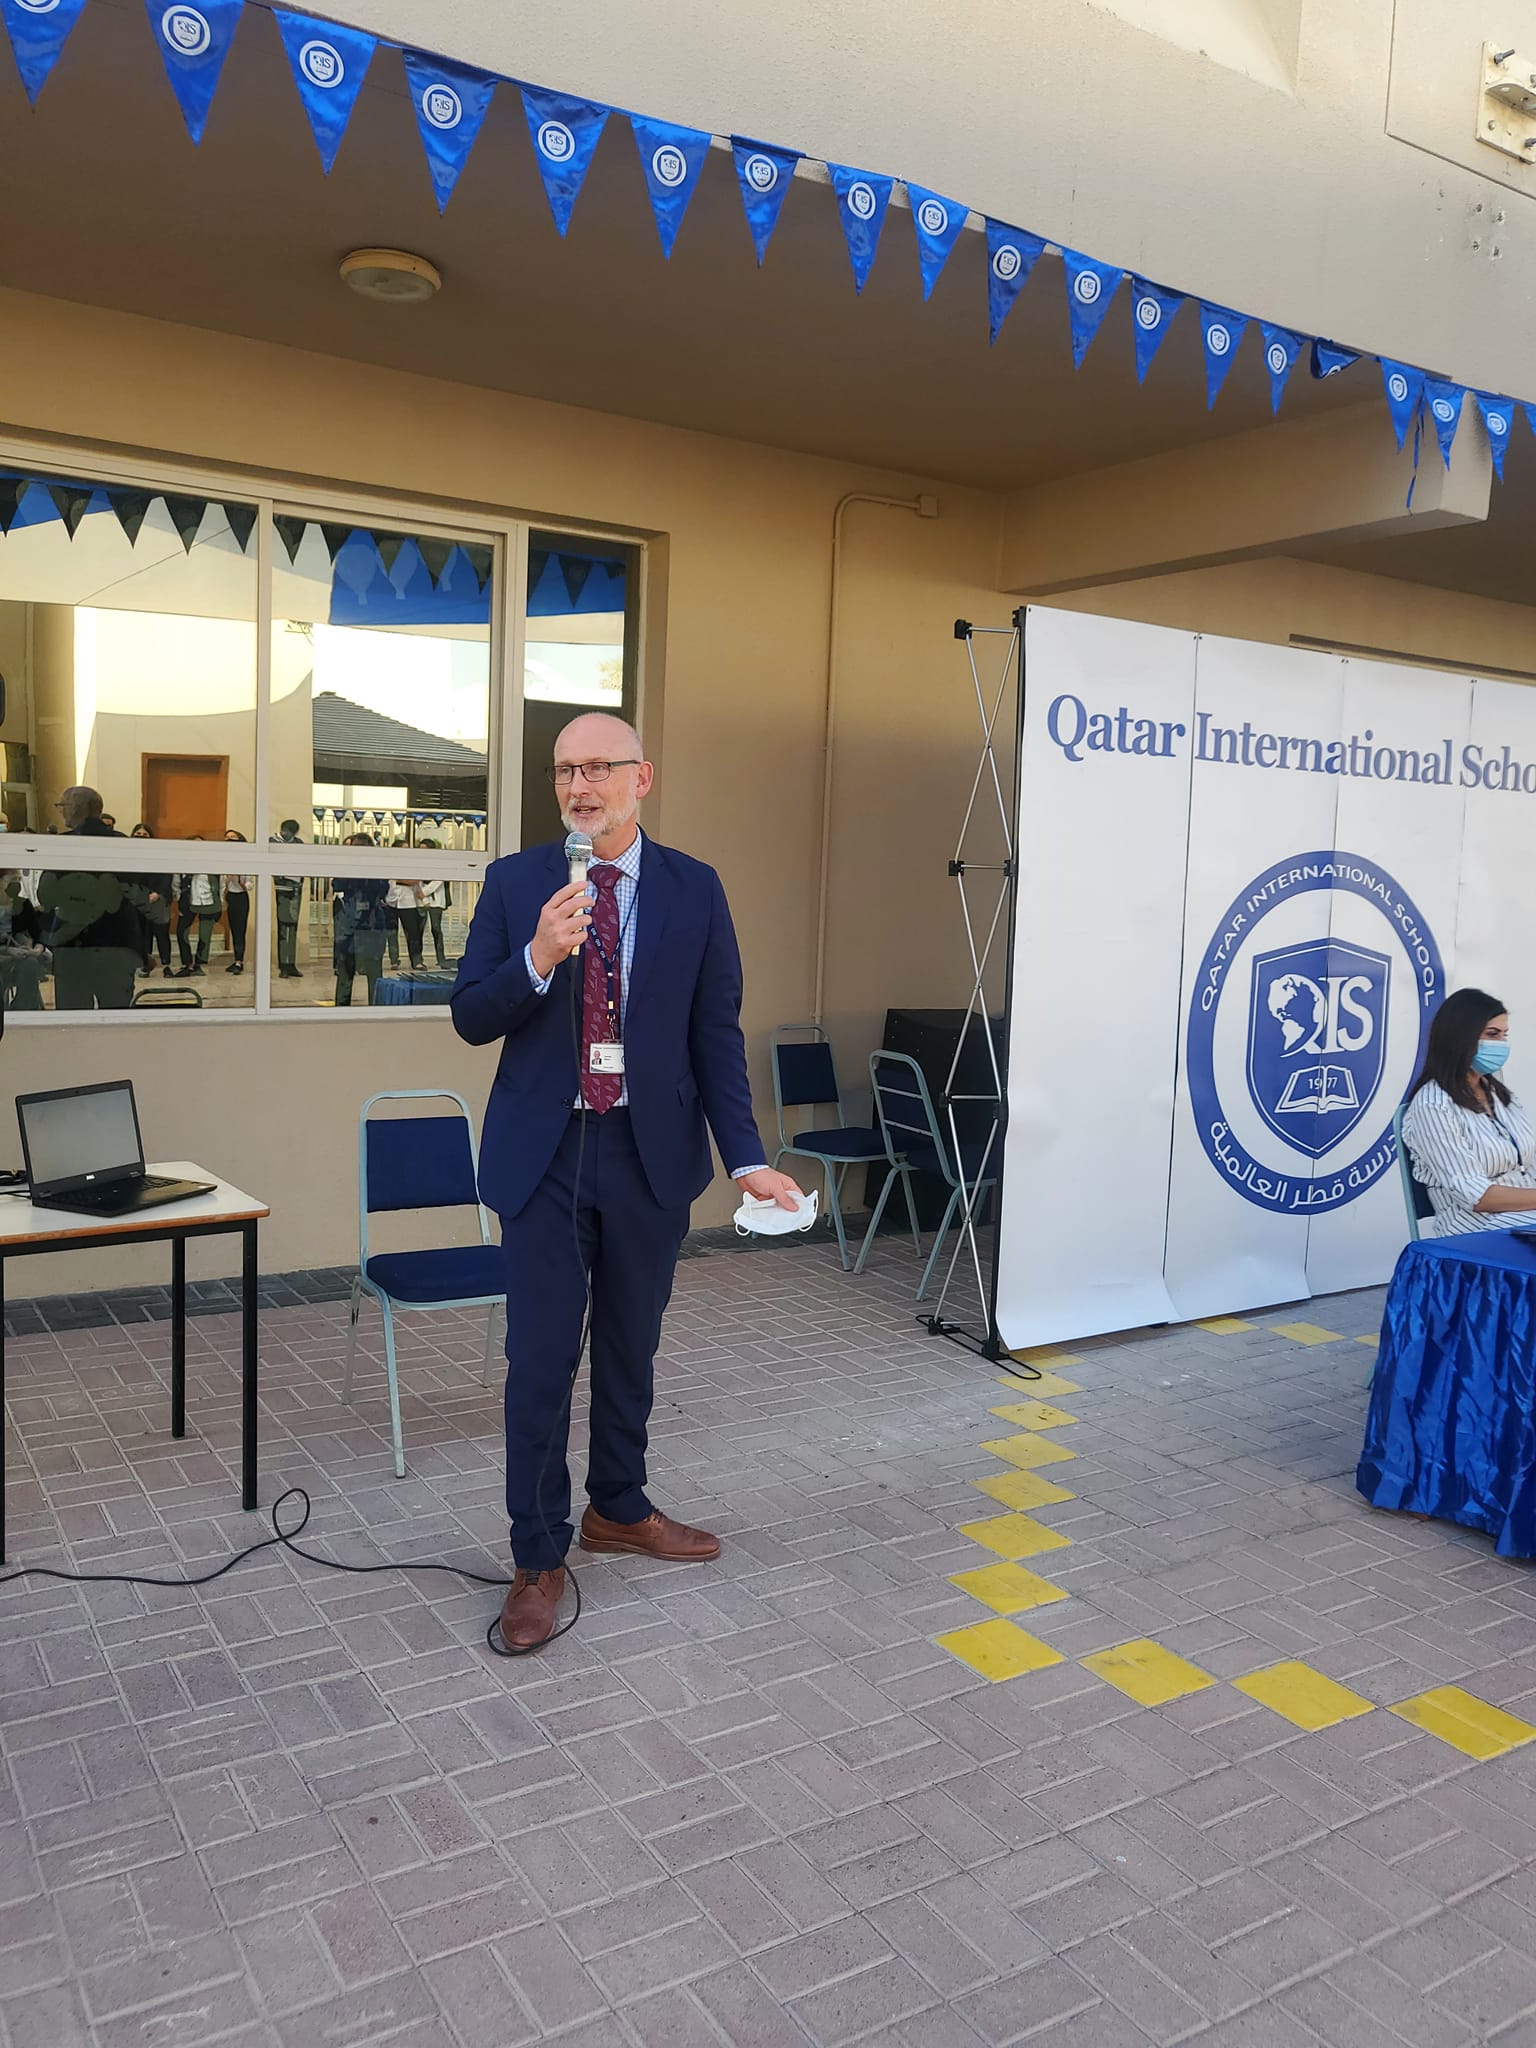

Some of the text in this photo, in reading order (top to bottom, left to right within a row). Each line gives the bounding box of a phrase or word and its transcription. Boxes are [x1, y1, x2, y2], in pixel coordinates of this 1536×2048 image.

[1047, 694, 1186, 763] Qatar
[1195, 711, 1454, 785] International
[1201, 864, 1435, 1012] QATAR INTERNATIONAL SCHOOL
[1308, 1076, 1338, 1090] 1977
[1210, 1121, 1288, 1202] العالمية
[1288, 1179, 1345, 1209] قطر
